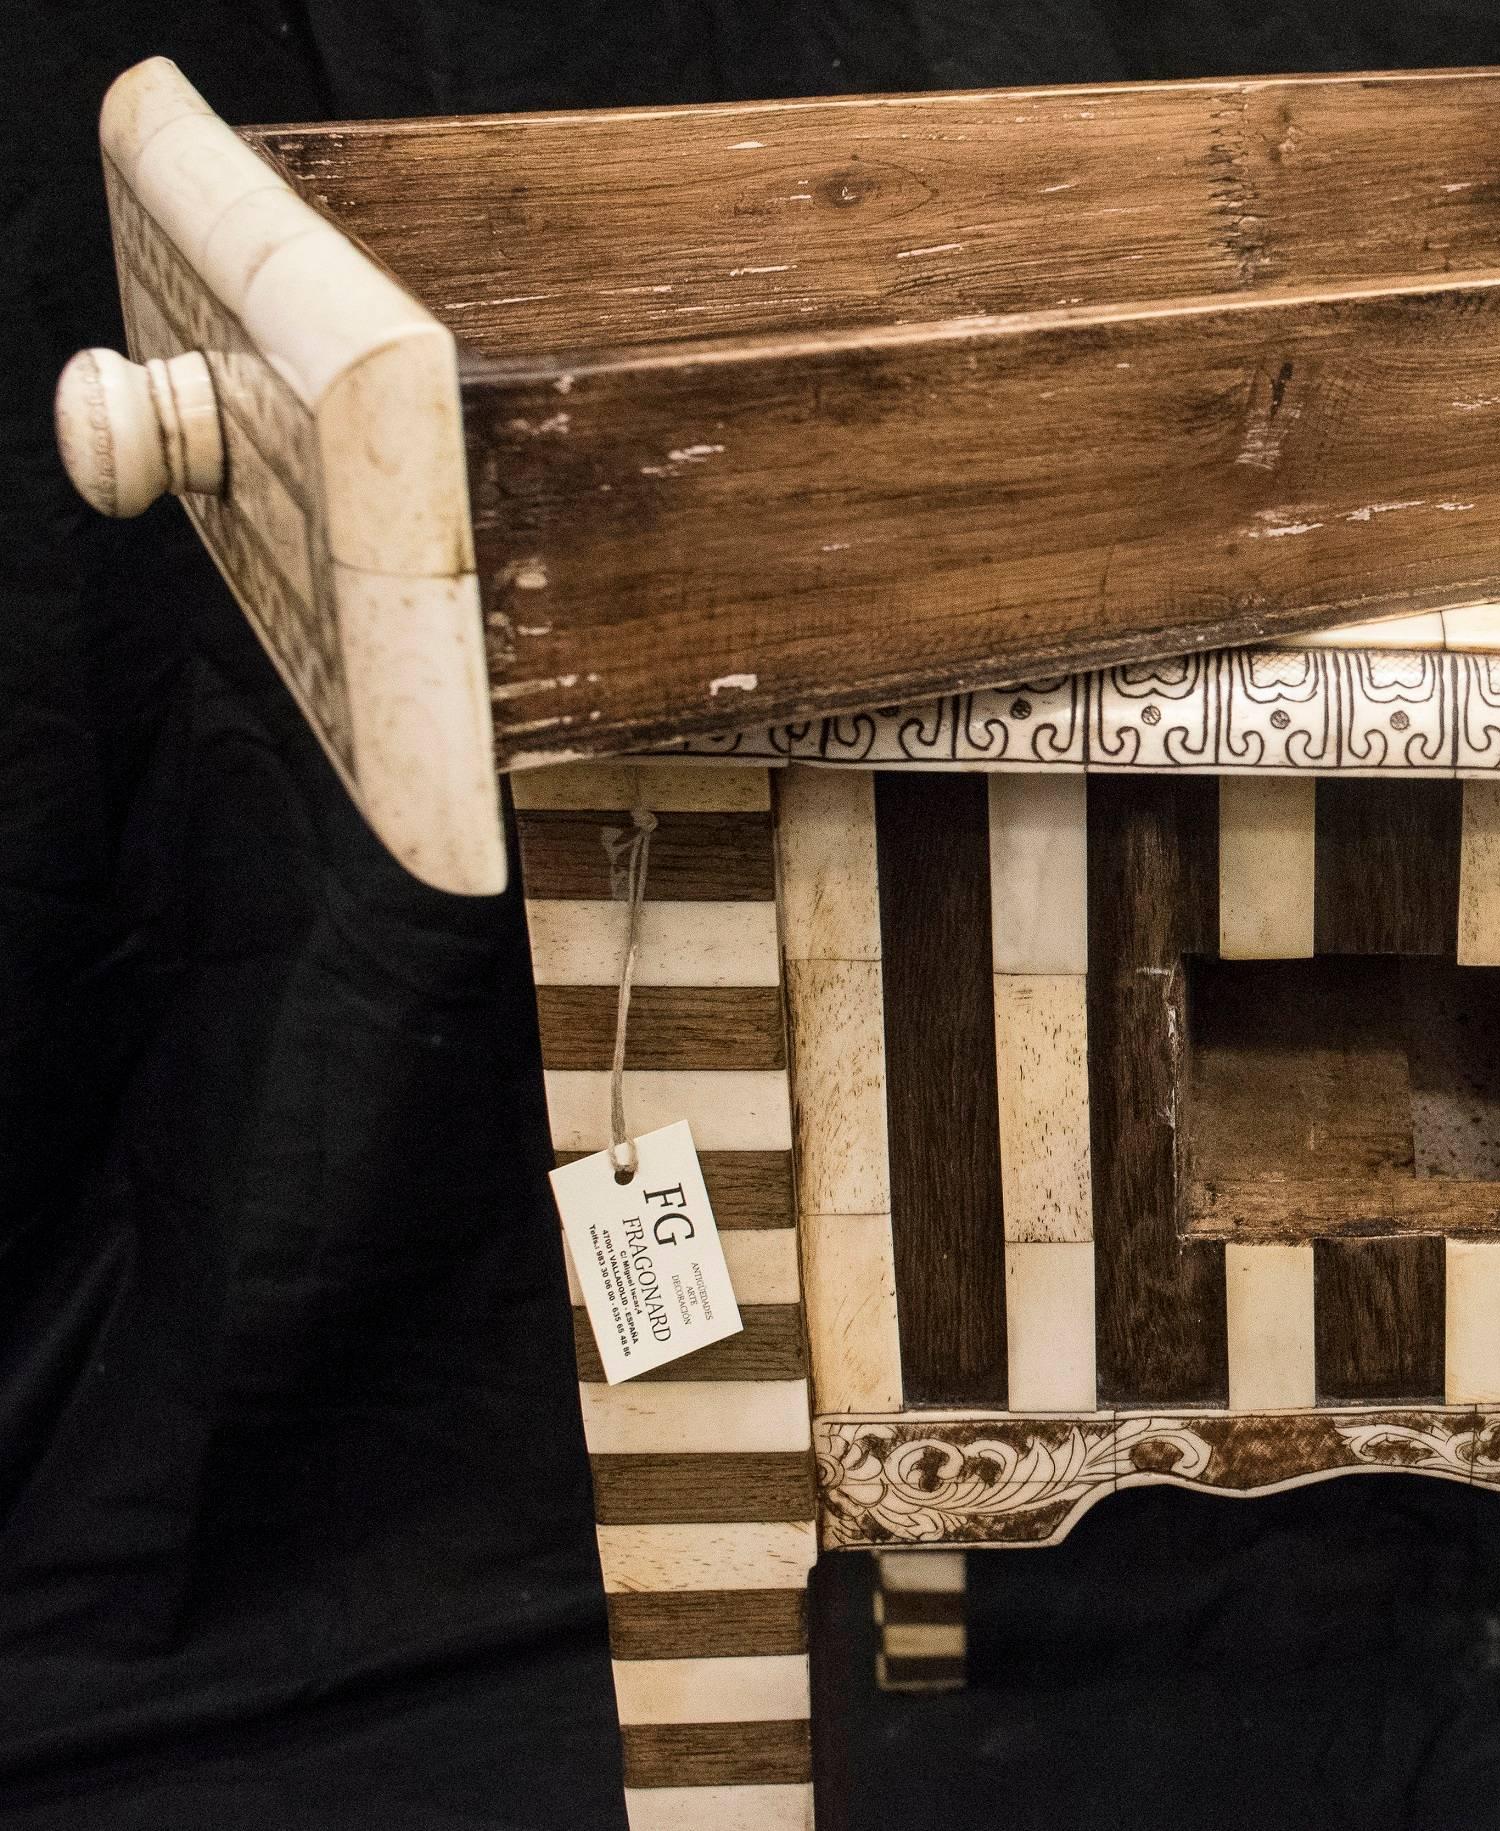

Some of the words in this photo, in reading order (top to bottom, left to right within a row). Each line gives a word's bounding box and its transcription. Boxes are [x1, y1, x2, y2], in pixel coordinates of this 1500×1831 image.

[643, 1182, 695, 1246] FG
[600, 1266, 610, 1279] 30
[604, 1278, 613, 1290] 06
[621, 1215, 672, 1342] FRAGONARD
[622, 1259, 636, 1287] Miguel
[602, 1229, 615, 1254] 47001
[609, 1254, 629, 1306] VALLADOLID
[624, 1311, 639, 1345] ESPAÑA
[607, 1290, 616, 1302] 00
[685, 1286, 698, 1306] ARTE
[671, 1274, 692, 1325] DECORACIÓN
[619, 1335, 628, 1346] 48
